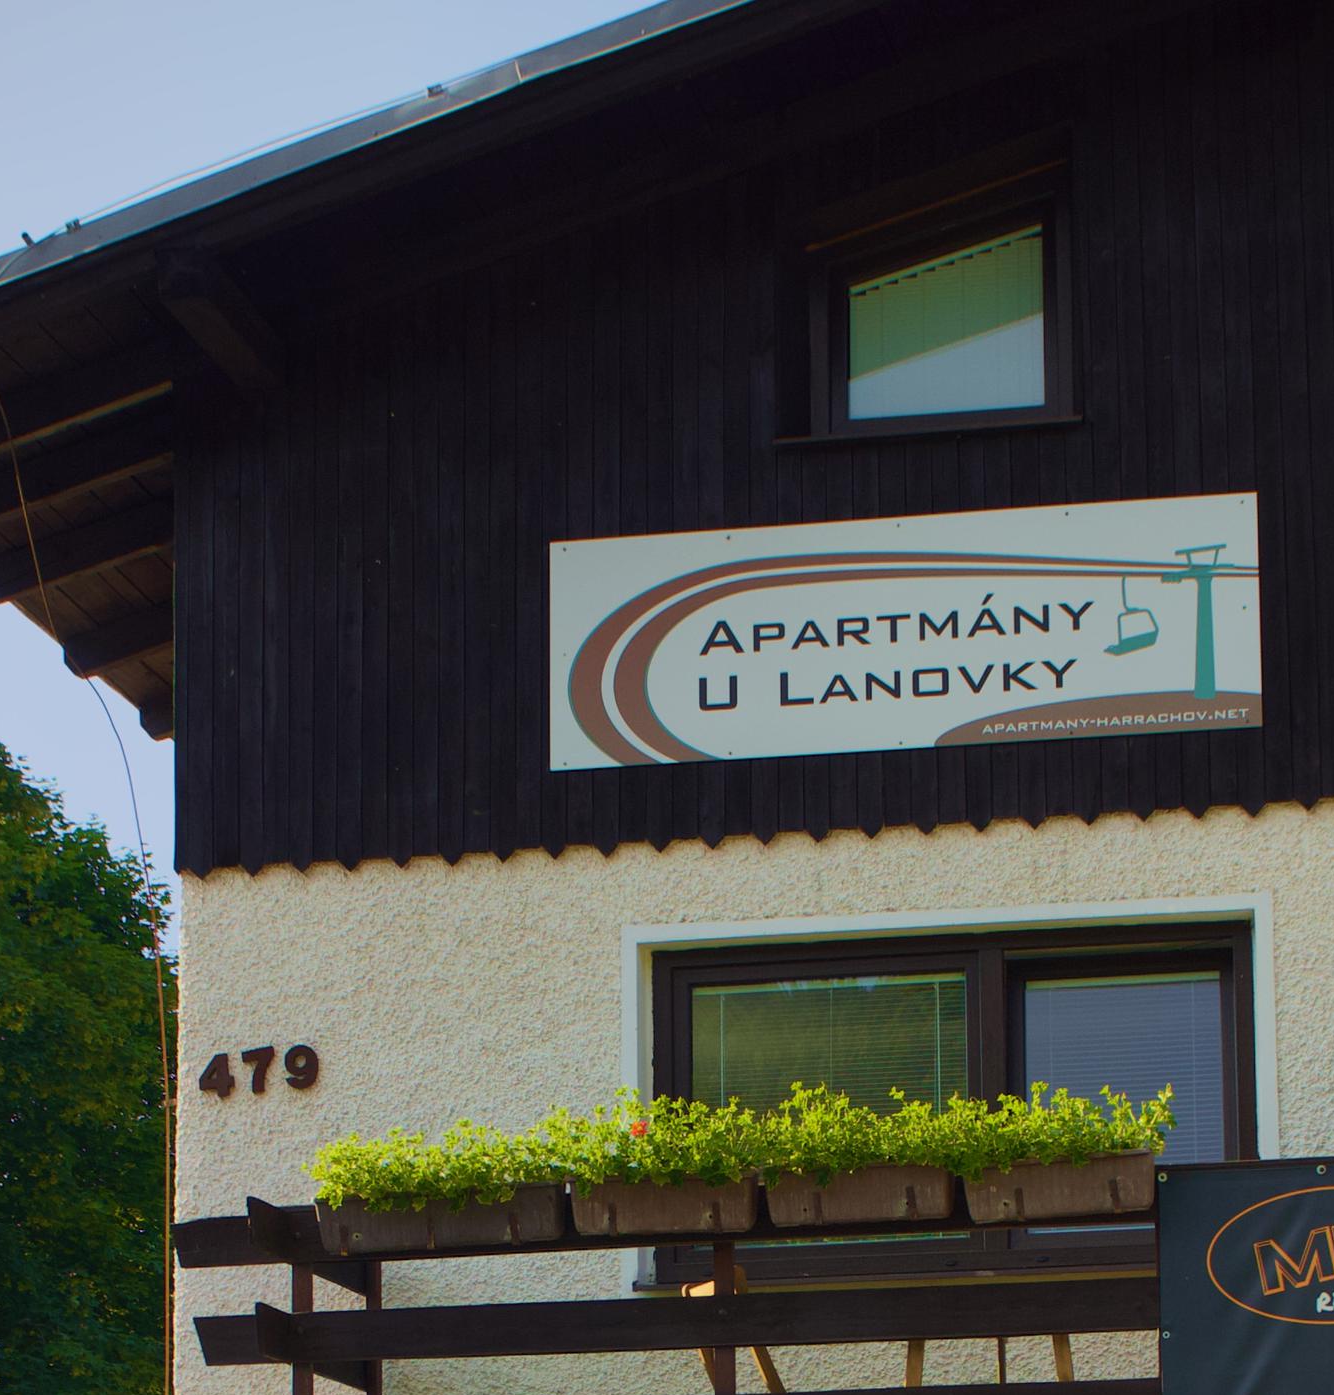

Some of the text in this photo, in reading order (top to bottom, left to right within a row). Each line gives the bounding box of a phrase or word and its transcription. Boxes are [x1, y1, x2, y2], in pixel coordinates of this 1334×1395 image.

[699, 592, 1094, 656] APARTMÁNY
[698, 659, 1078, 711] U LANOVKY
[981, 708, 1250, 735] APARTMANY-HARRACHOV.NET
[198, 1044, 320, 1098] 479
